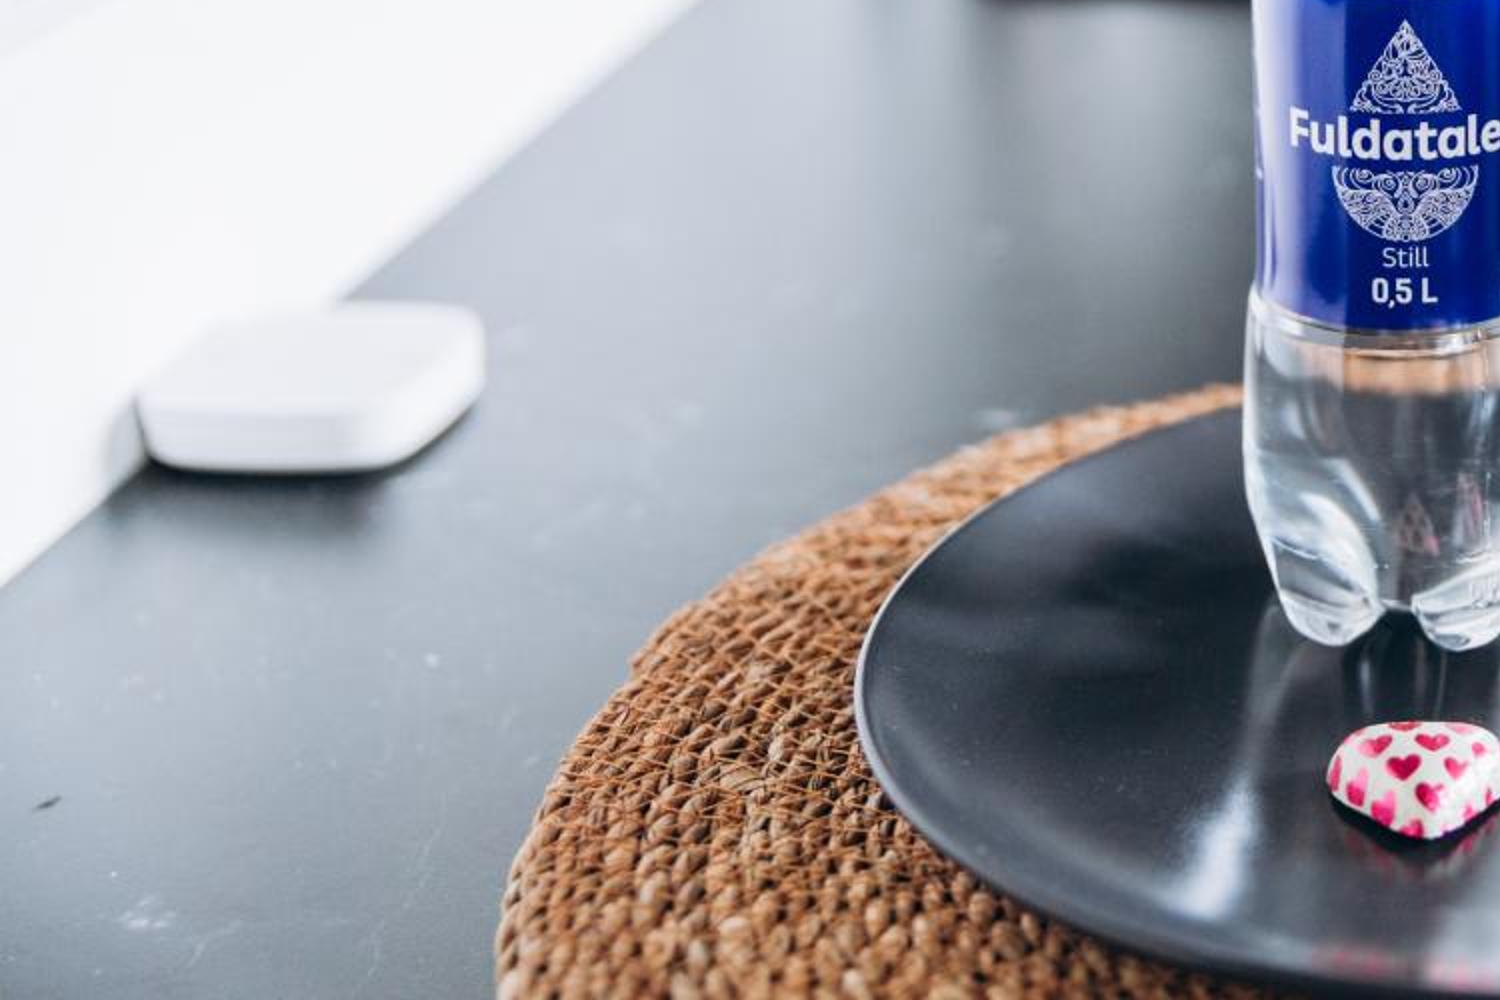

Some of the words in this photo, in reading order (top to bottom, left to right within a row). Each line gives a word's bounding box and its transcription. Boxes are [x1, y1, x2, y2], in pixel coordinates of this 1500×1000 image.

[1382, 246, 1429, 267] Still
[1372, 278, 1411, 309] 0,5
[1421, 278, 1438, 303] L
